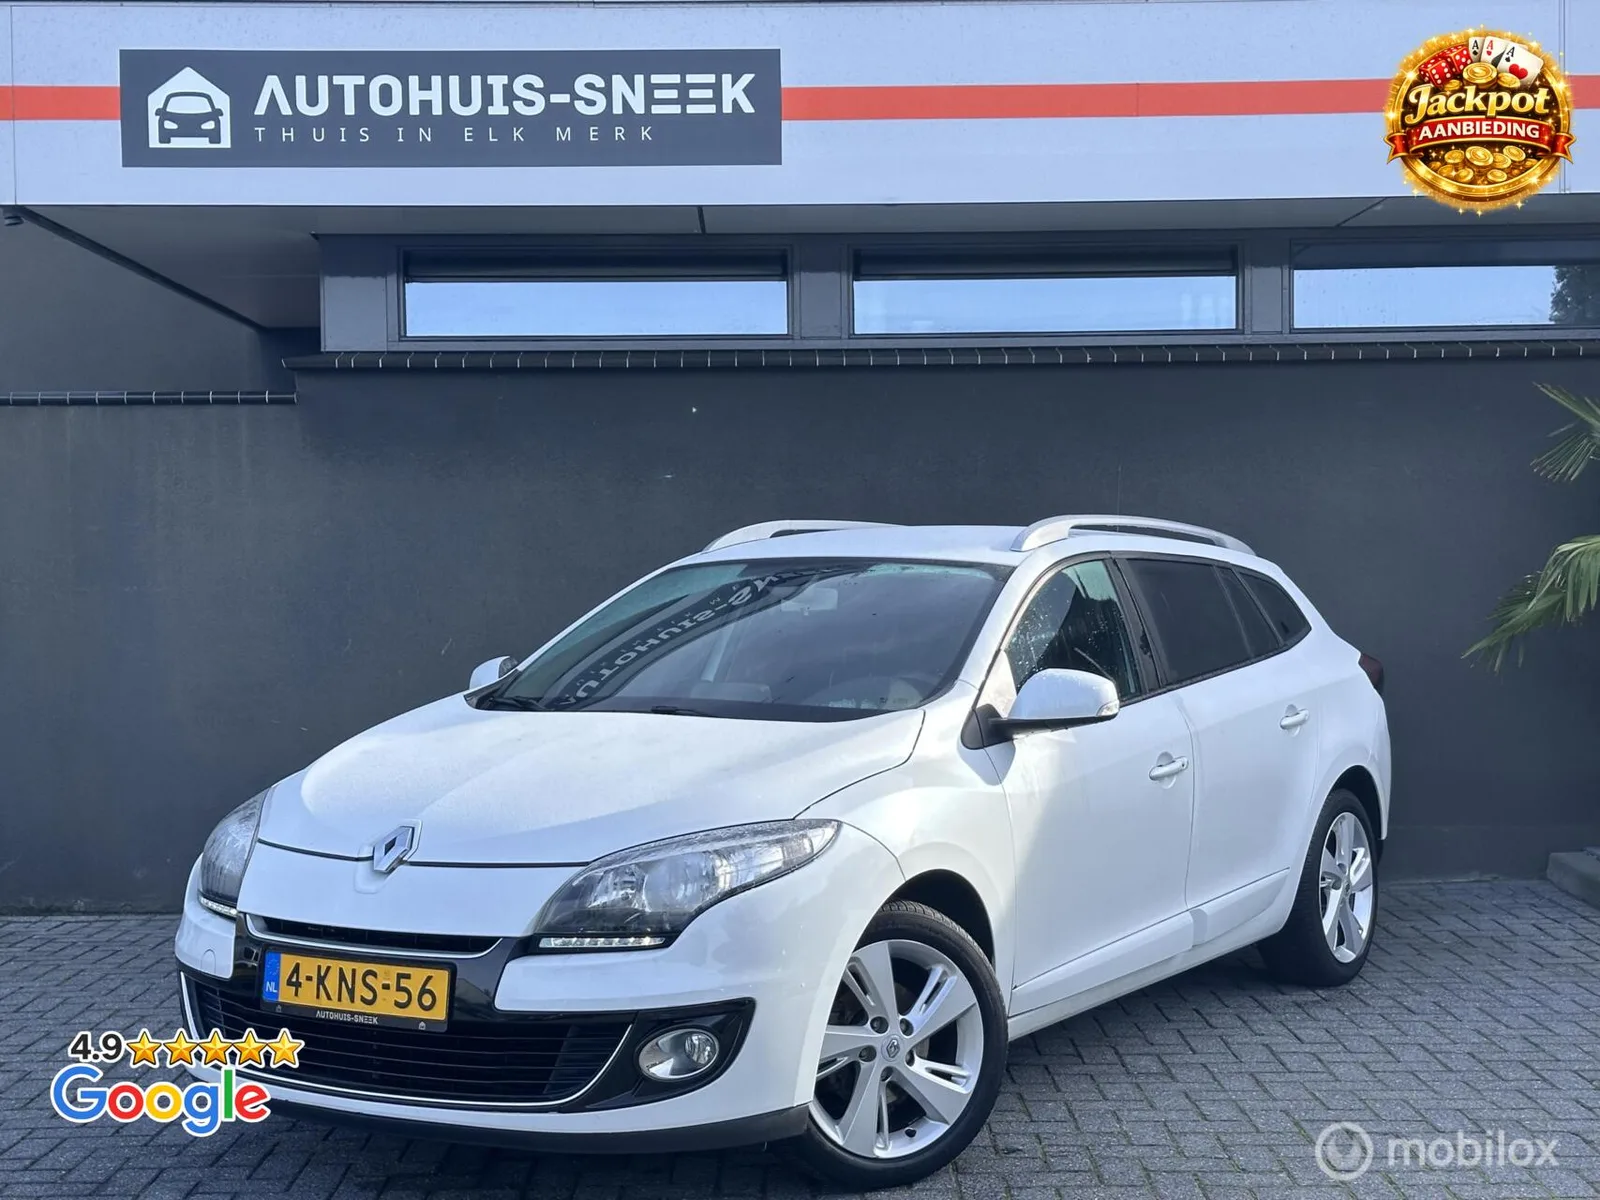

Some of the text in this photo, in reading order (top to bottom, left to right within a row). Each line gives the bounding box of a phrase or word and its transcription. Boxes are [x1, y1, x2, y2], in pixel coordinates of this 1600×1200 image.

[253, 73, 756, 117] AUTOHUIS-SNEEK
[253, 126, 653, 142] THUIS IN ELK MERK
[265, 981, 278, 993] NL
[285, 961, 438, 1012] 4-KNS-56
[315, 1009, 379, 1025] AUTOHUIS-SNEEK
